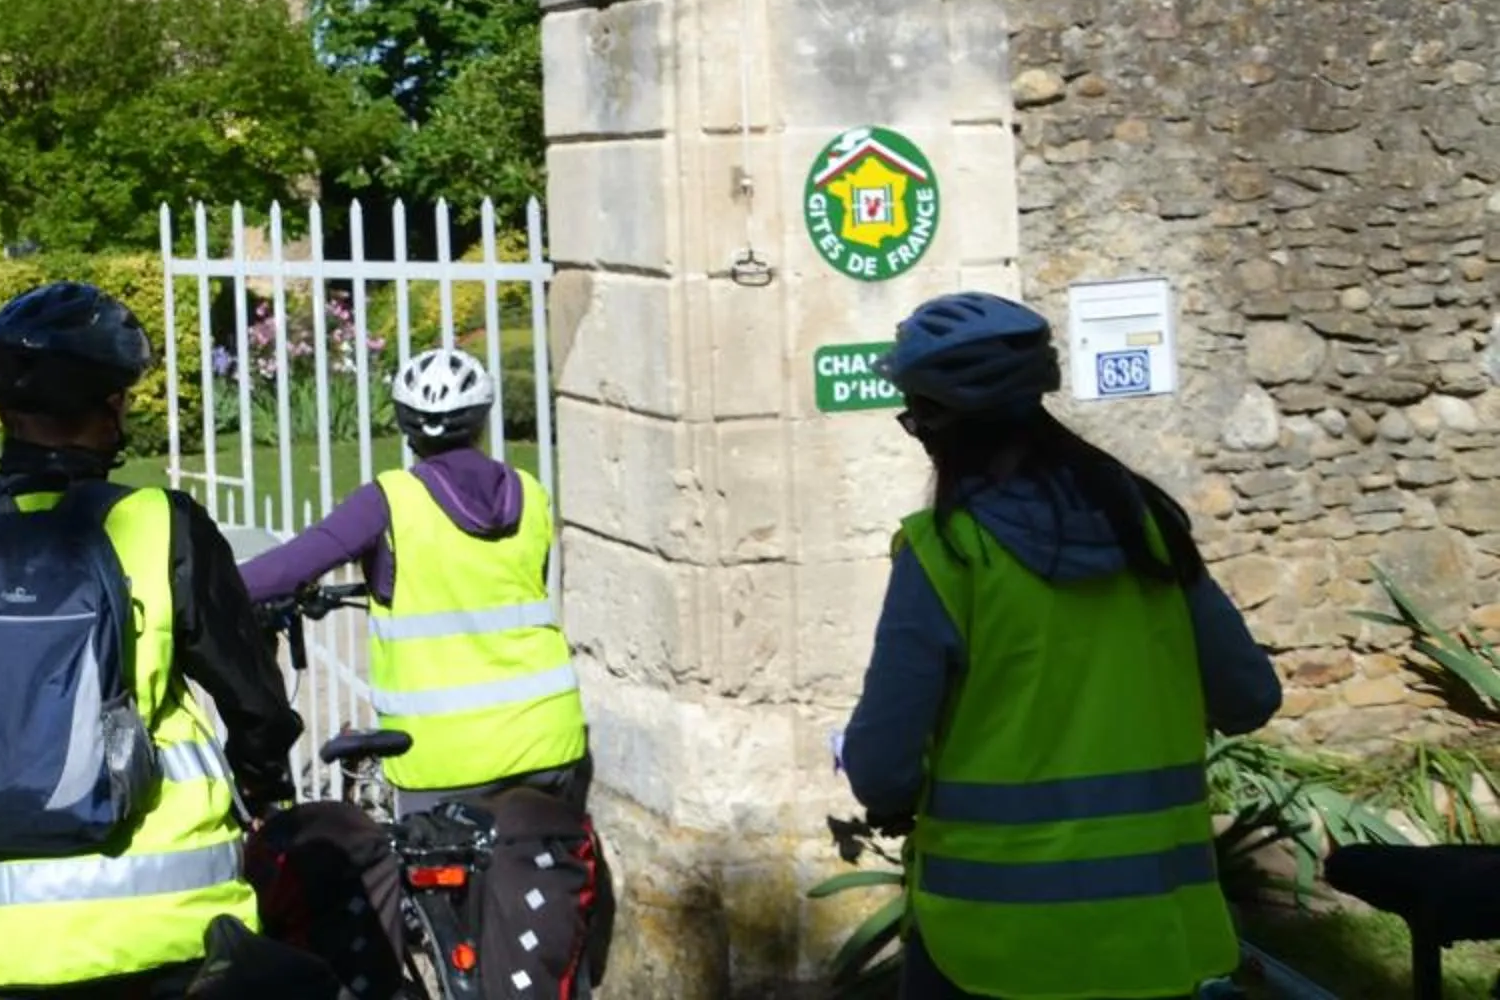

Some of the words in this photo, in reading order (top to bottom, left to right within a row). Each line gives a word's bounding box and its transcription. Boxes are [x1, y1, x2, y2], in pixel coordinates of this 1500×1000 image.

[847, 252, 877, 276] DE
[886, 187, 935, 271] FRANCE
[1104, 357, 1143, 386] 636
